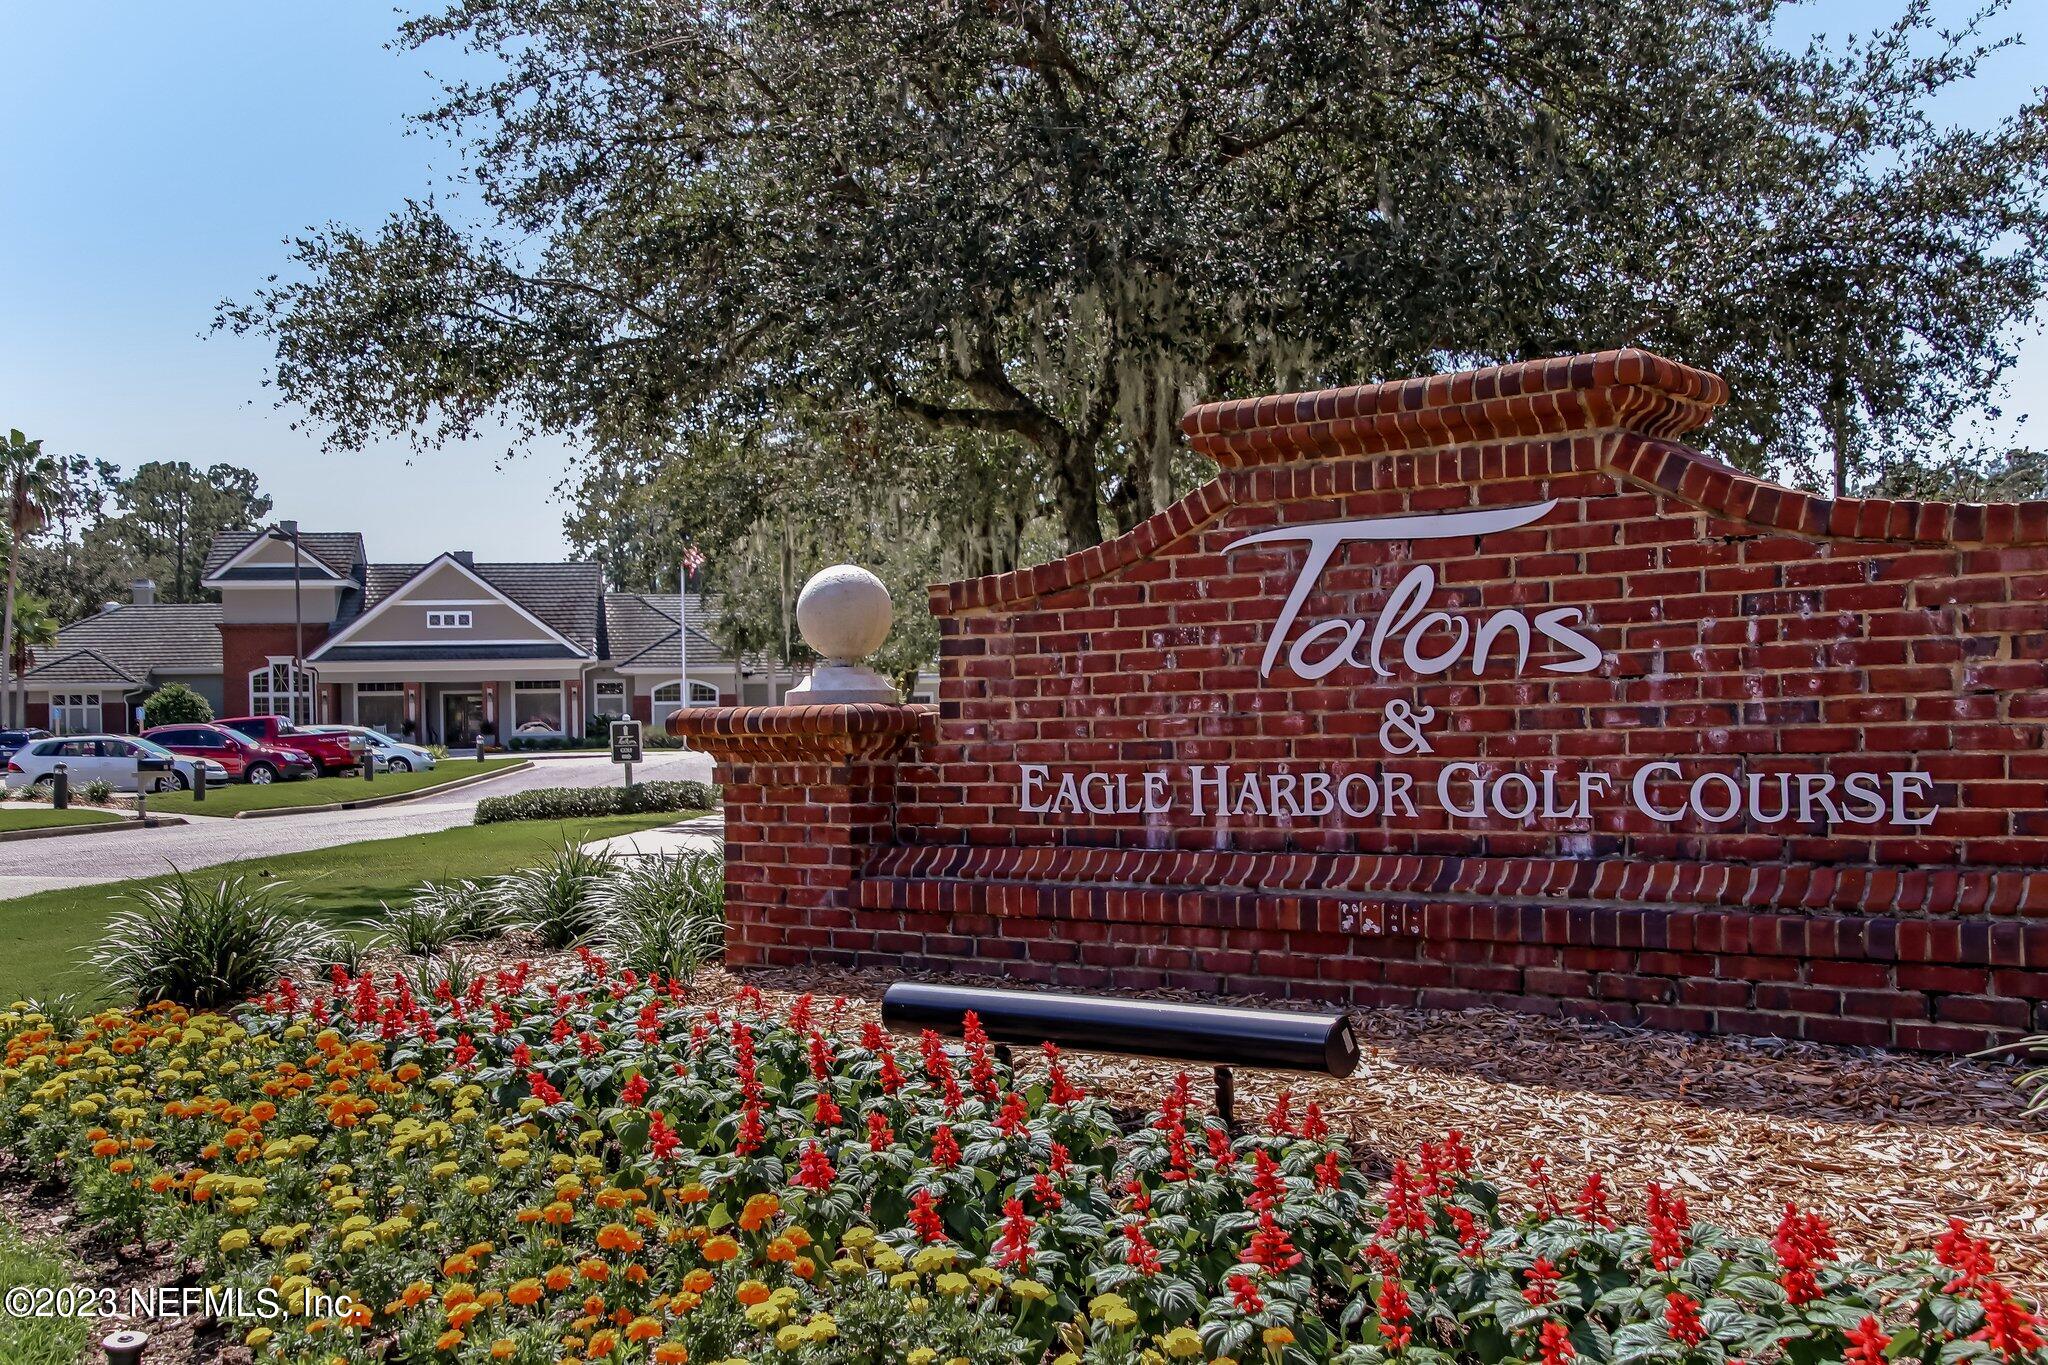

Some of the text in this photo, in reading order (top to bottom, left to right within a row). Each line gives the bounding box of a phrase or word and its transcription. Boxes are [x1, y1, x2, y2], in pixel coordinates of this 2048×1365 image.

[1220, 498, 1602, 680] Talons
[1379, 699, 1435, 755] &
[1018, 761, 1940, 826] EAGLE HARBOR GOLF COURSE
